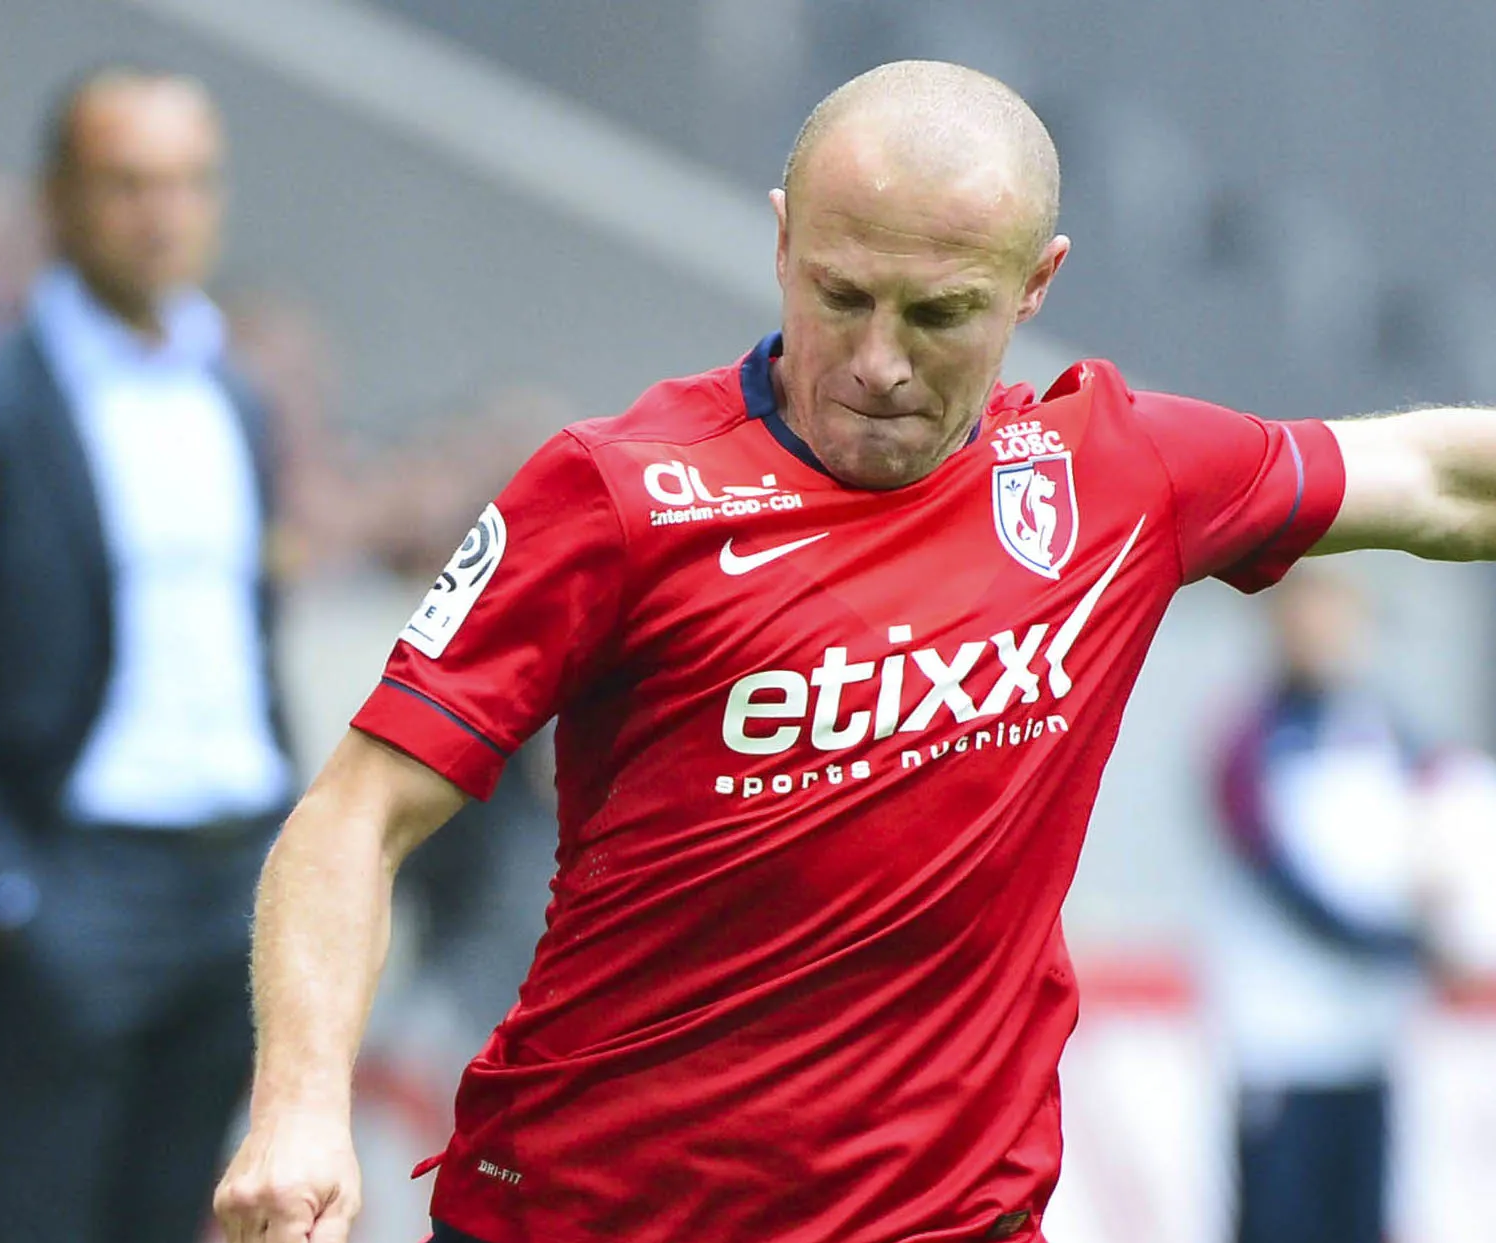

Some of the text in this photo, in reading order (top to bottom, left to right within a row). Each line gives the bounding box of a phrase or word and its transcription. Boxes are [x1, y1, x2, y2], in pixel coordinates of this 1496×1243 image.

[990, 430, 1064, 461] LOSC
[996, 421, 1042, 439] LILLE
[721, 600, 1073, 756] etixx
[714, 759, 872, 798] sports
[477, 1159, 522, 1184] DRI-FIT
